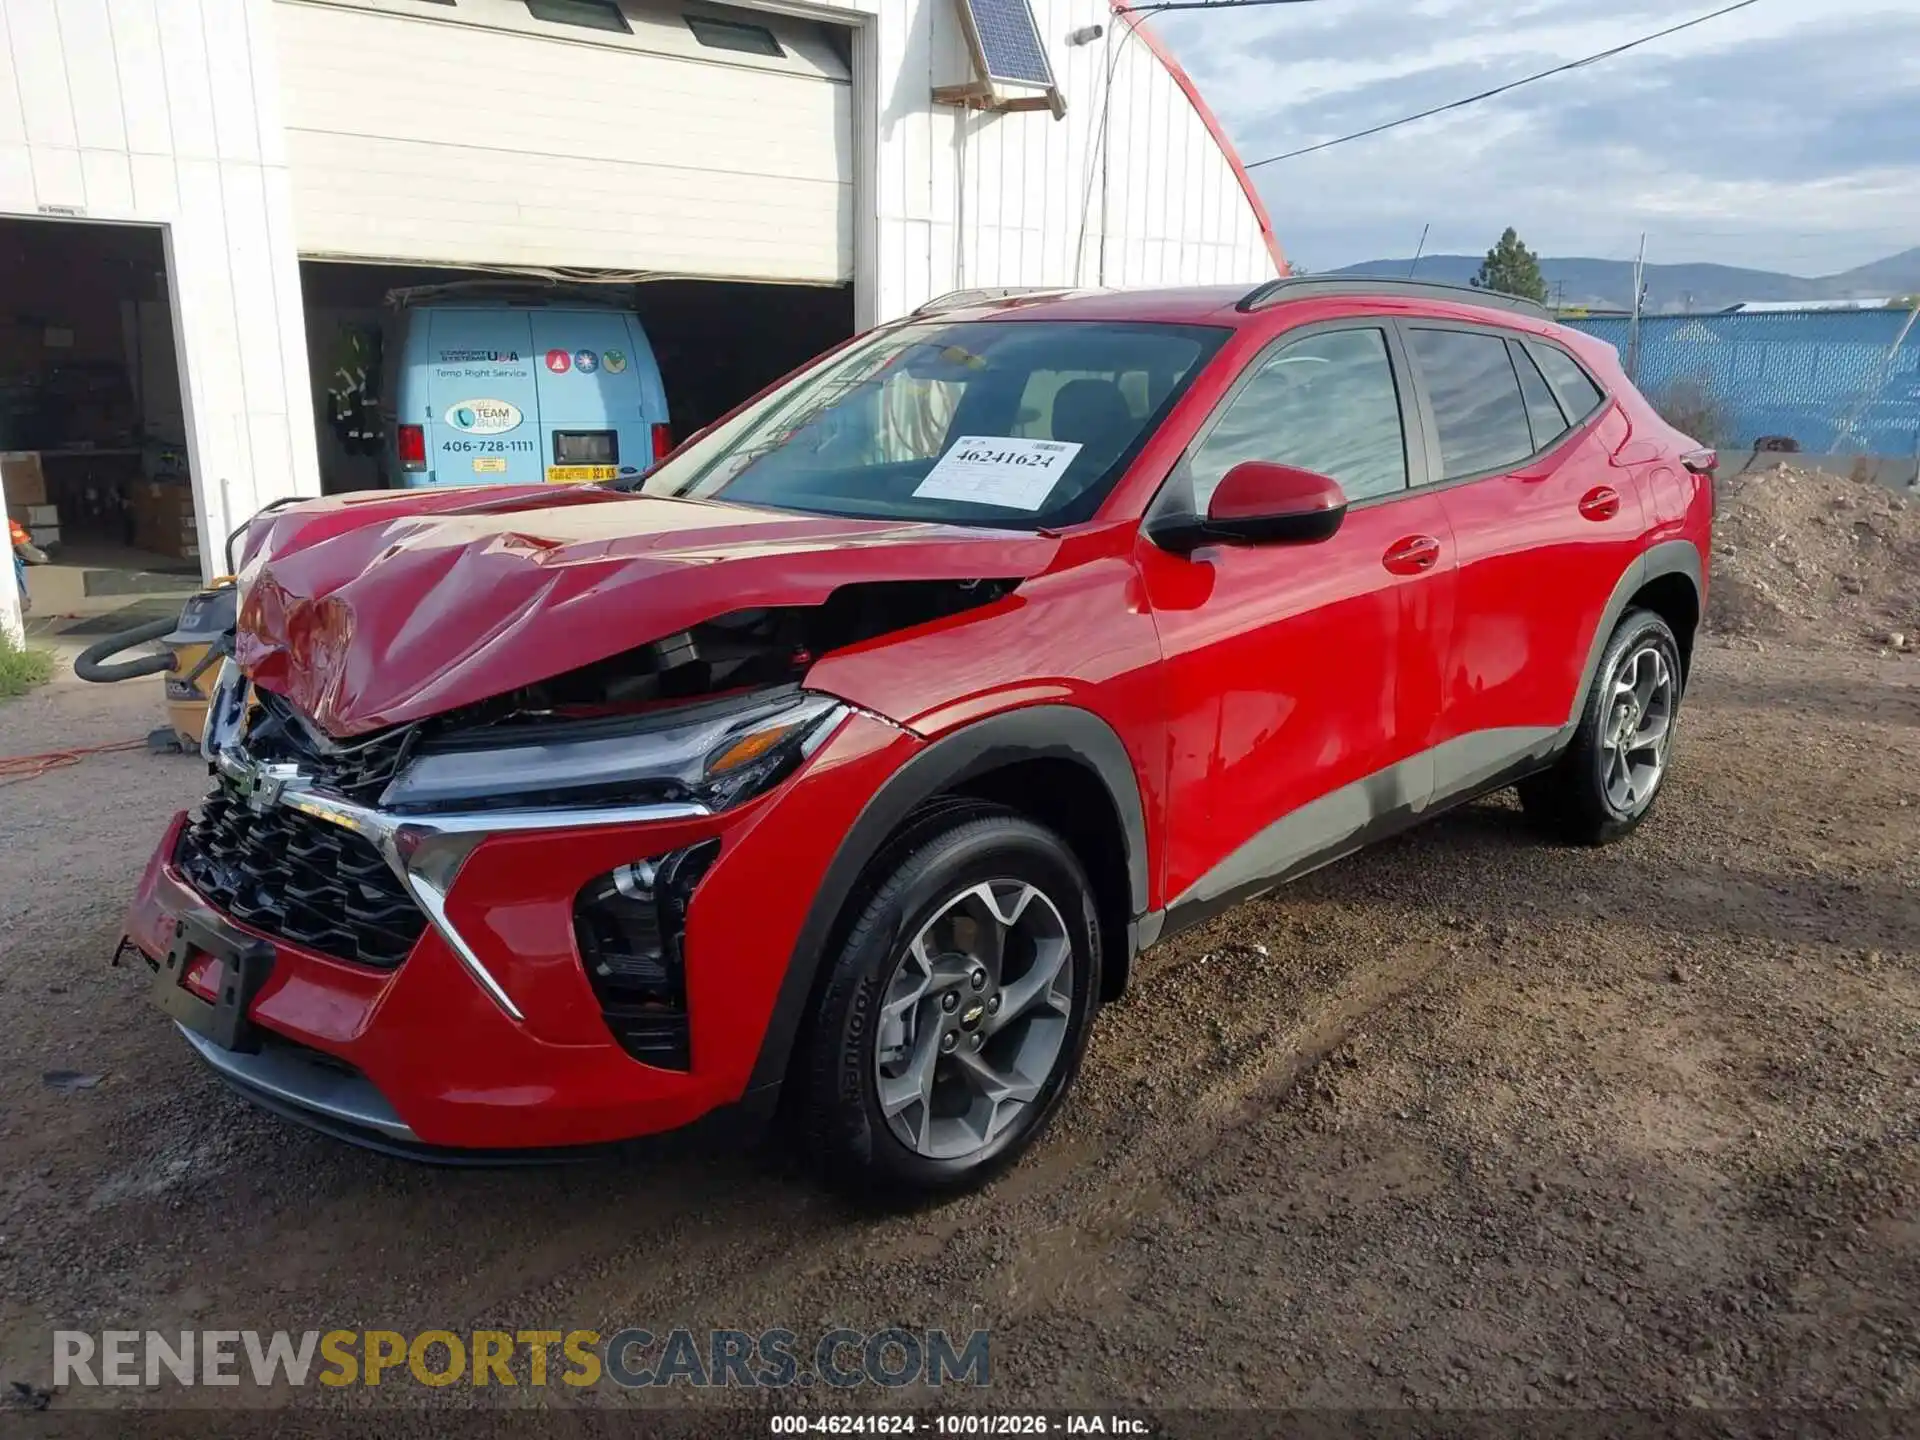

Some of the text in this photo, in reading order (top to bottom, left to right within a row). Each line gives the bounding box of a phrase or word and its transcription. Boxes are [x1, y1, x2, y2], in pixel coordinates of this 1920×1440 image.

[436, 368, 527, 378] Temp Right Service
[476, 408, 510, 418] TEAM
[442, 440, 534, 452] 406-728-1111
[956, 449, 1055, 468] 46241624
